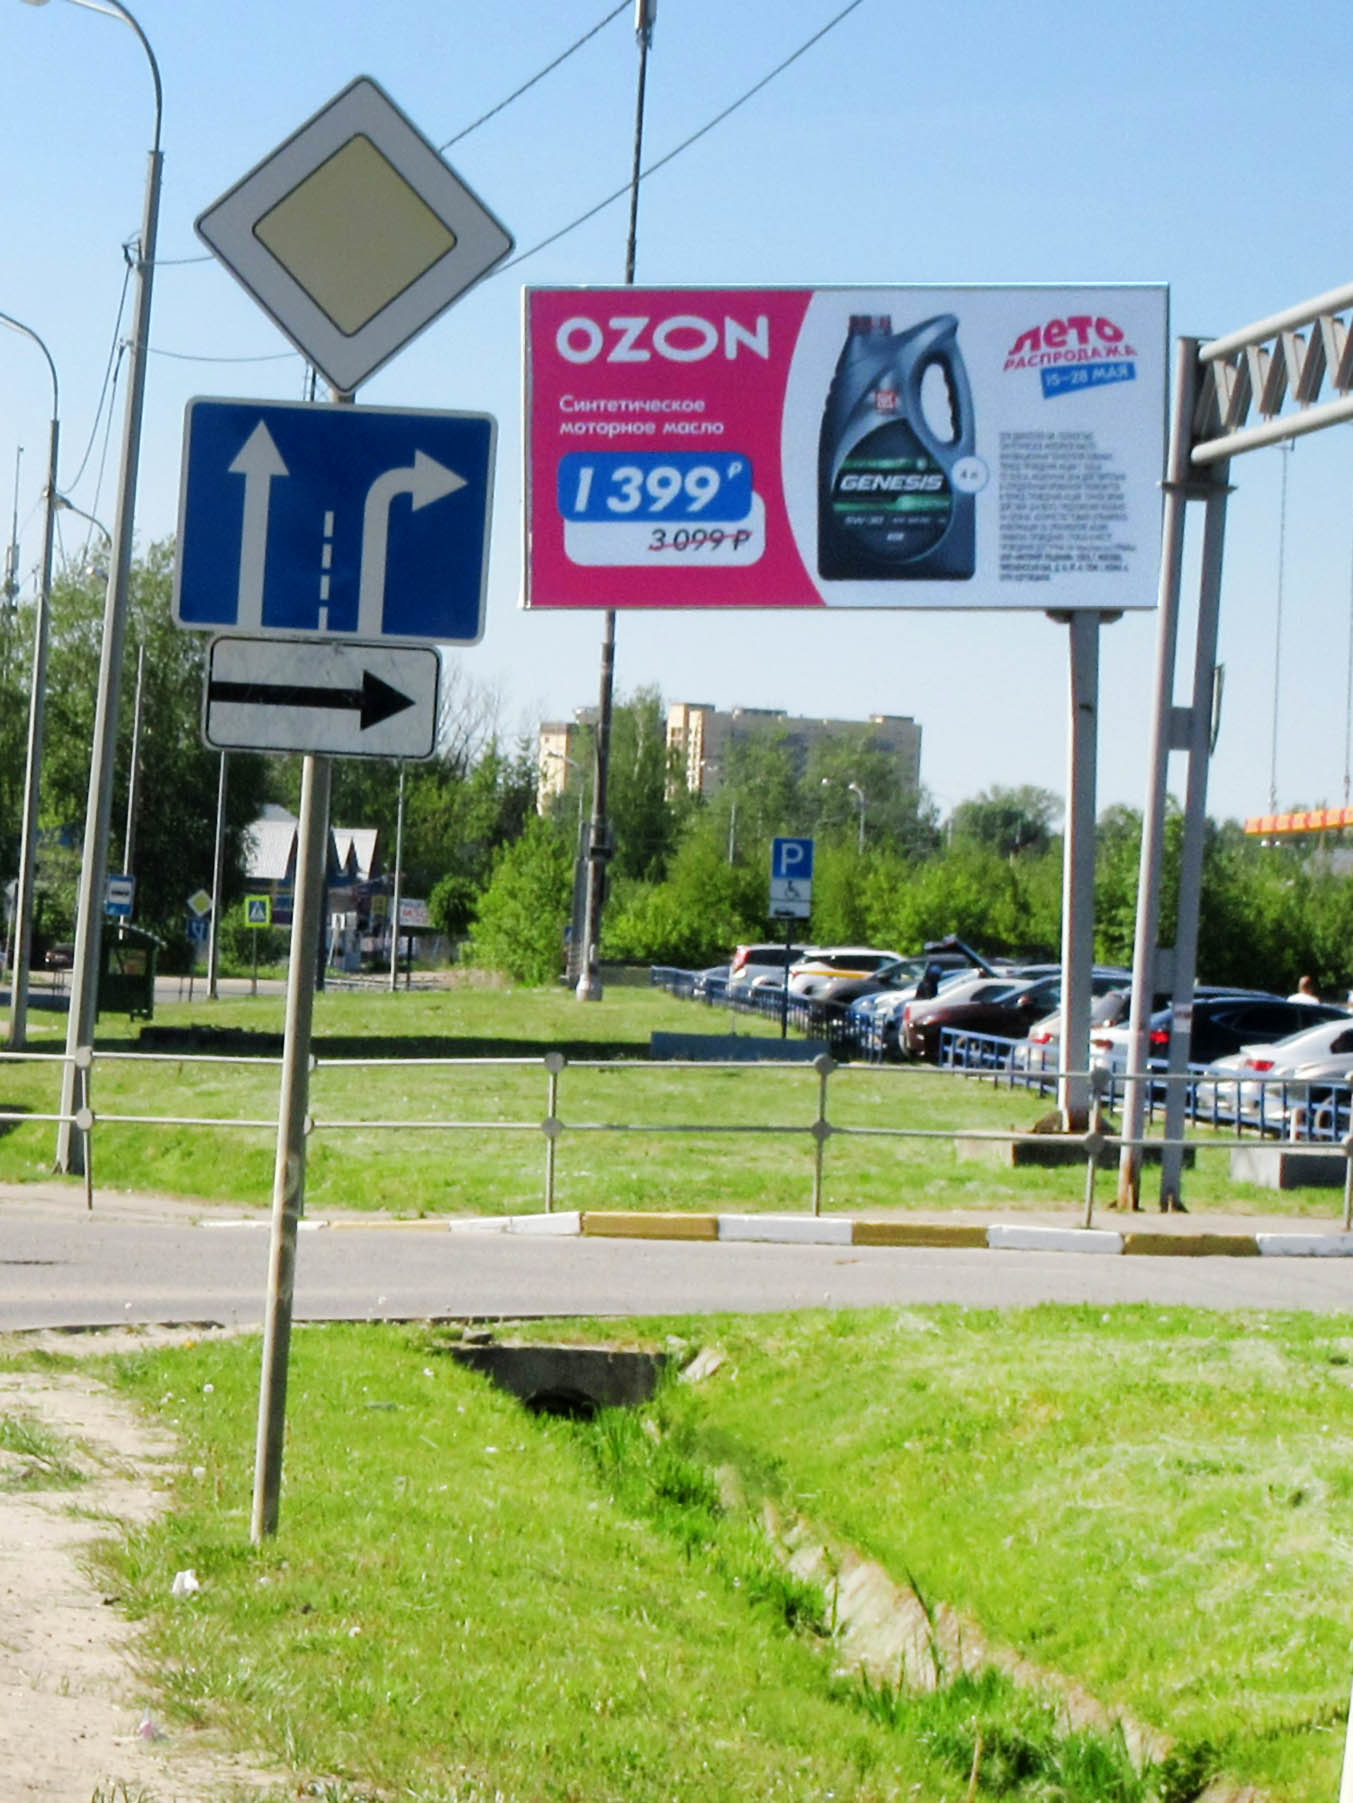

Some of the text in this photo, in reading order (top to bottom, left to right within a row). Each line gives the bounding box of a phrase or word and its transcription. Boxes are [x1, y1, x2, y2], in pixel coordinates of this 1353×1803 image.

[556, 315, 770, 364] OZON
[1093, 365, 1129, 380] МАЯ
[559, 395, 705, 412] Синтетическое
[559, 422, 724, 438] моторное масло
[840, 475, 943, 490] GENESIS
[780, 843, 804, 875] P
